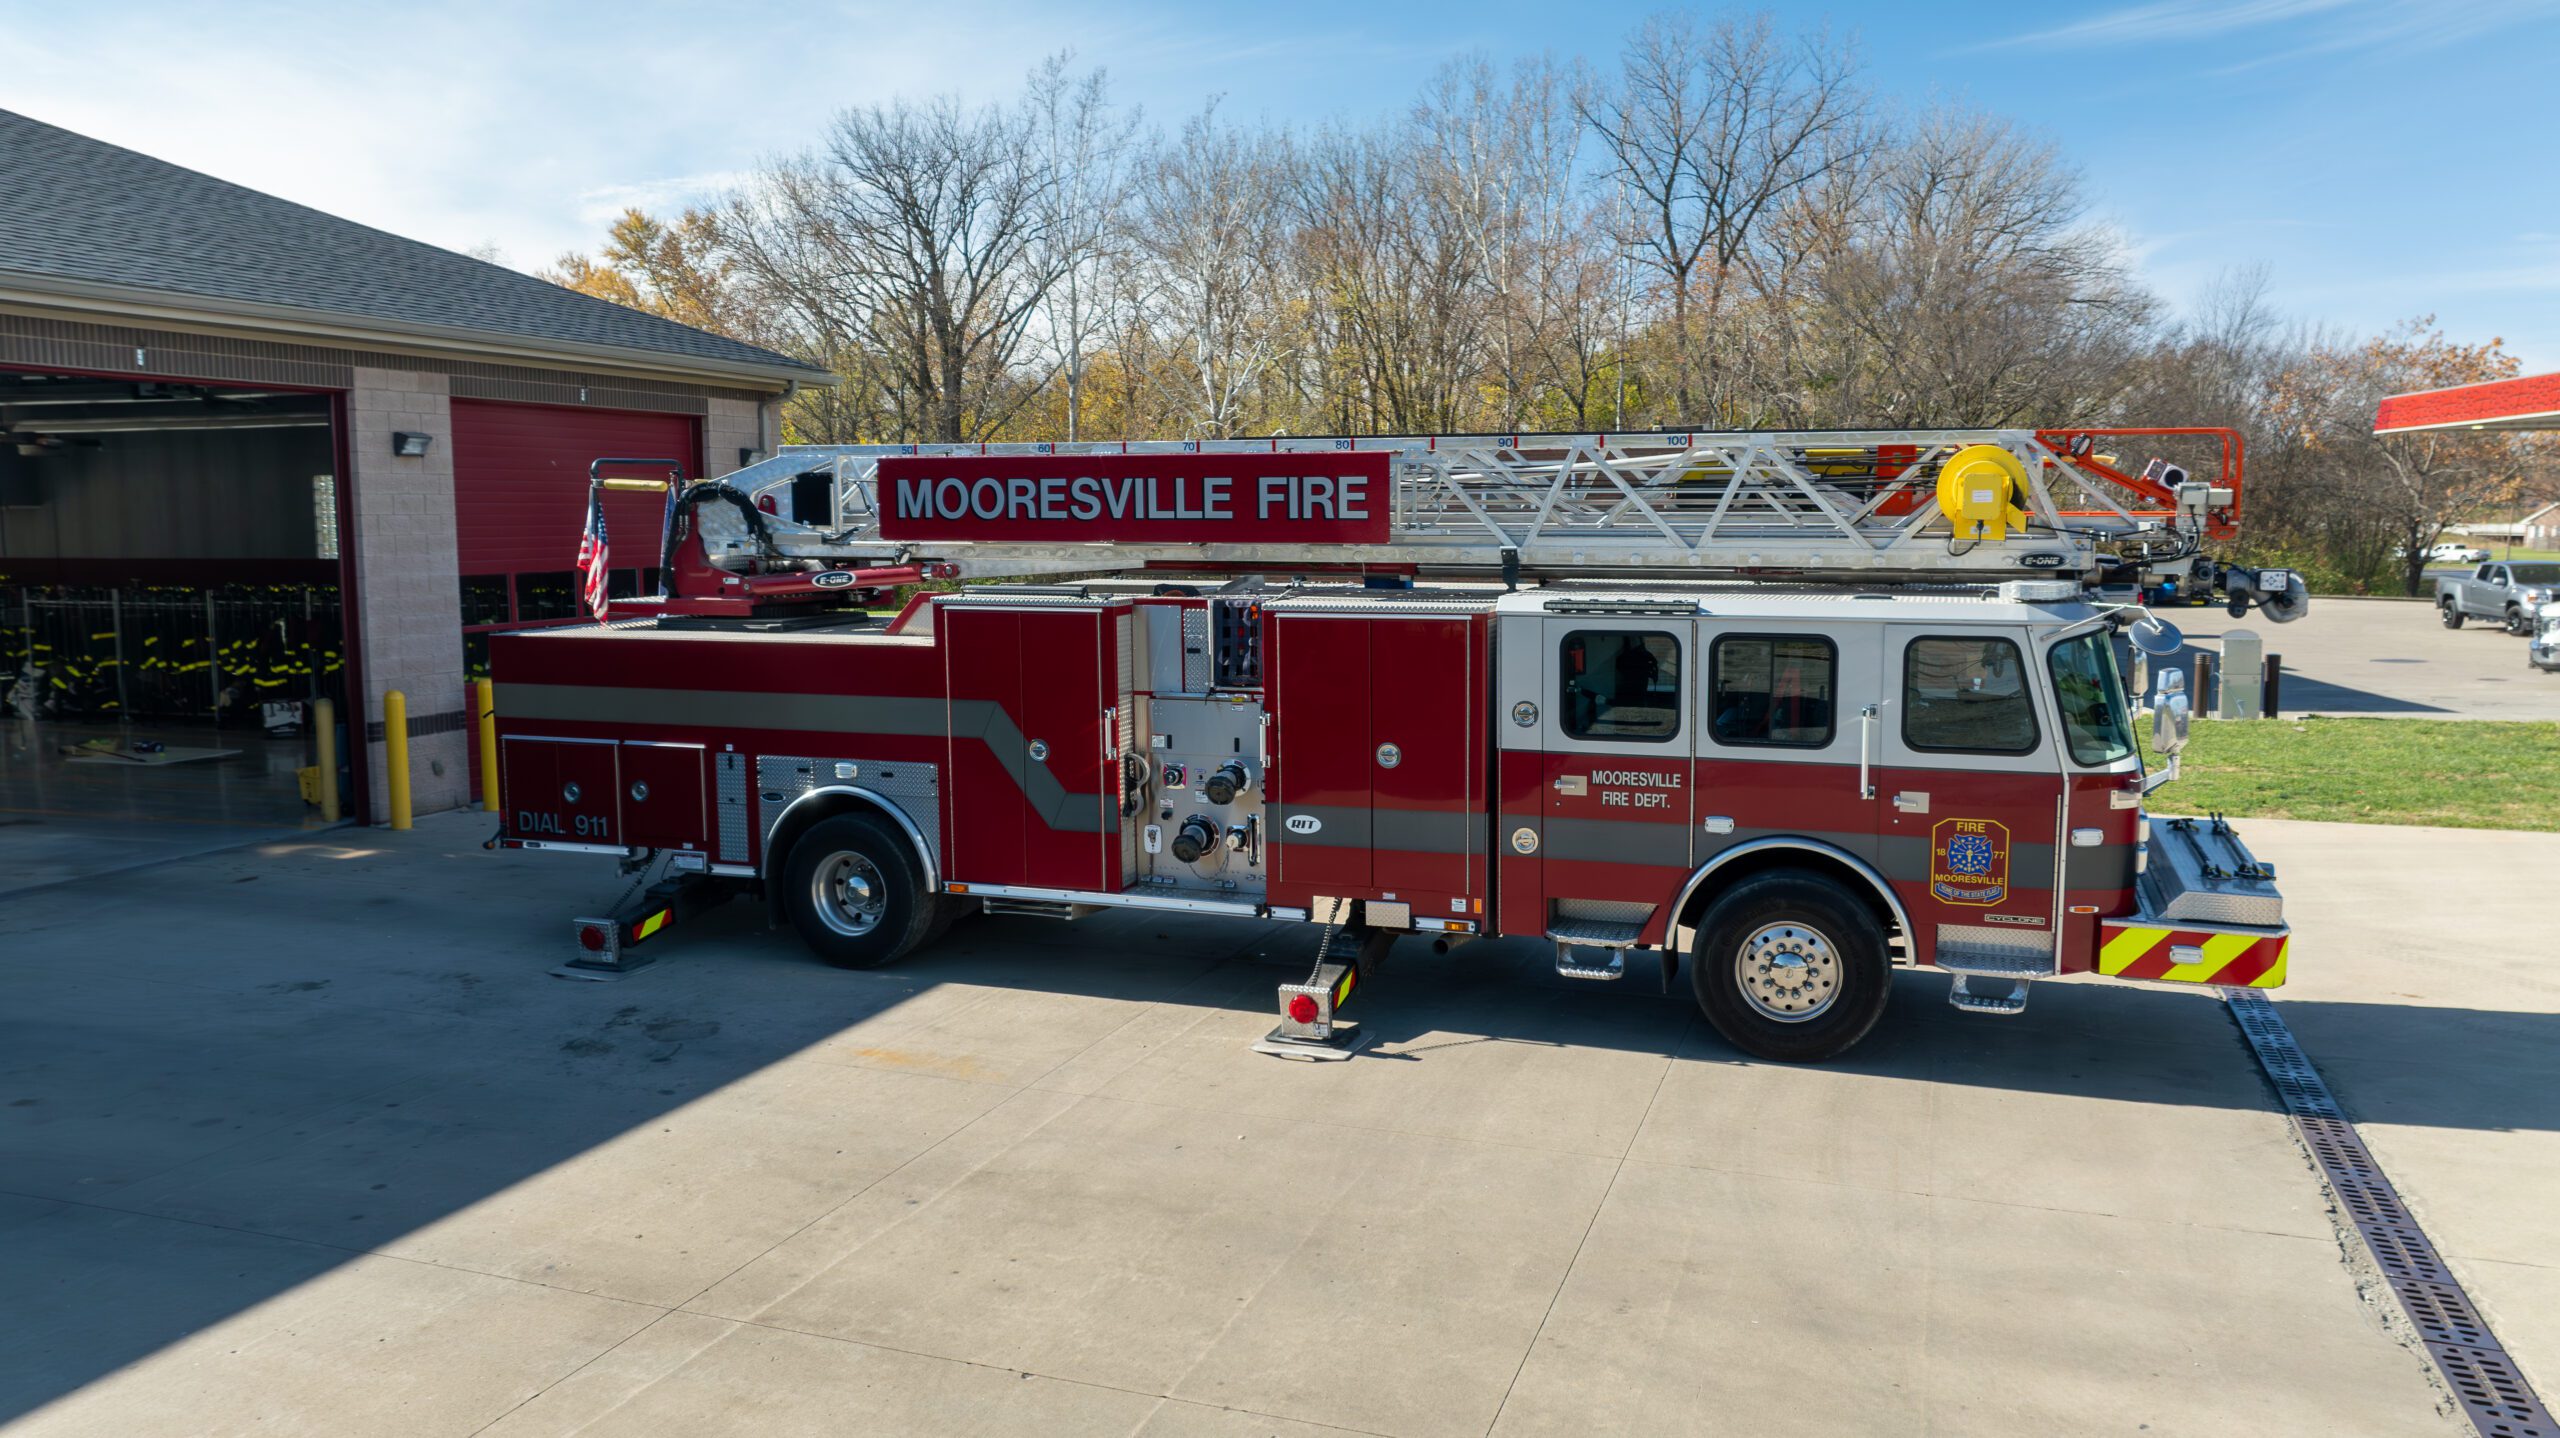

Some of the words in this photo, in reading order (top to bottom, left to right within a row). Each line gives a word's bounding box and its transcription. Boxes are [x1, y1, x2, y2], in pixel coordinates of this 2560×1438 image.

[901, 445, 914, 454] 50
[1038, 444, 1051, 453] 60
[1182, 442, 1195, 451] 70
[1335, 440, 1349, 450] 80
[1498, 438, 1513, 448] 90
[1666, 436, 1688, 446] 100
[897, 477, 1234, 520] MOORESVILLE
[1257, 476, 1369, 520] FIRE
[2024, 557, 2060, 565] E-ONE
[1592, 770, 1681, 788] MOORESVILLE
[1602, 791, 1630, 806] FIRE
[1634, 792, 1671, 809] DEPT.
[519, 811, 564, 834] DIAL
[575, 814, 608, 837] 911
[1290, 819, 1317, 830] RIT
[1956, 821, 1986, 833] FIRE
[1936, 848, 1946, 856] 18
[1994, 851, 2005, 860] 77
[1935, 874, 2004, 885] MOORESVILLE
